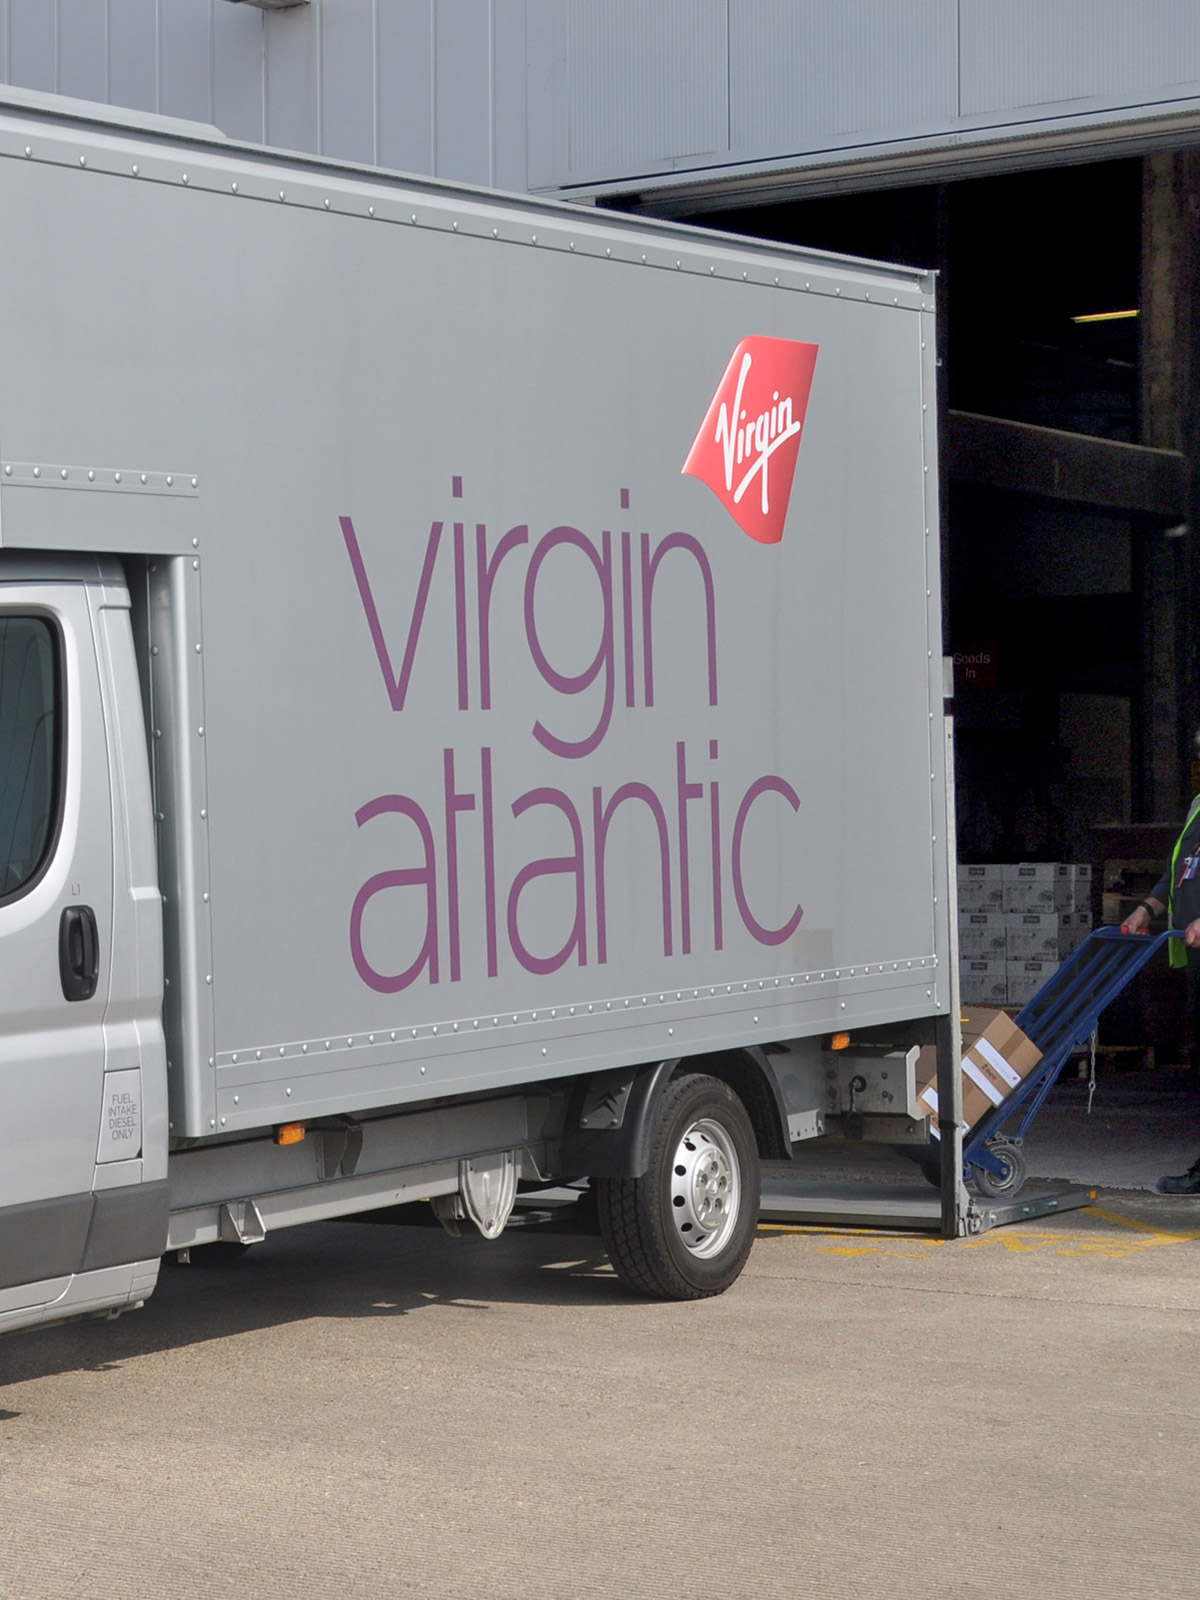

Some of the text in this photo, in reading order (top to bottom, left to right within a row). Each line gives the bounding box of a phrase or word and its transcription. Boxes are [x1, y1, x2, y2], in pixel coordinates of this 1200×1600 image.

[715, 352, 801, 514] Virgin
[338, 475, 718, 759] virgin
[953, 653, 990, 665] Goods
[349, 739, 804, 994] atlantic
[112, 1093, 133, 1105] FUEL
[108, 1104, 137, 1117] INTAKE
[109, 1116, 136, 1129] DIESEL
[112, 1129, 134, 1140] ONLY
